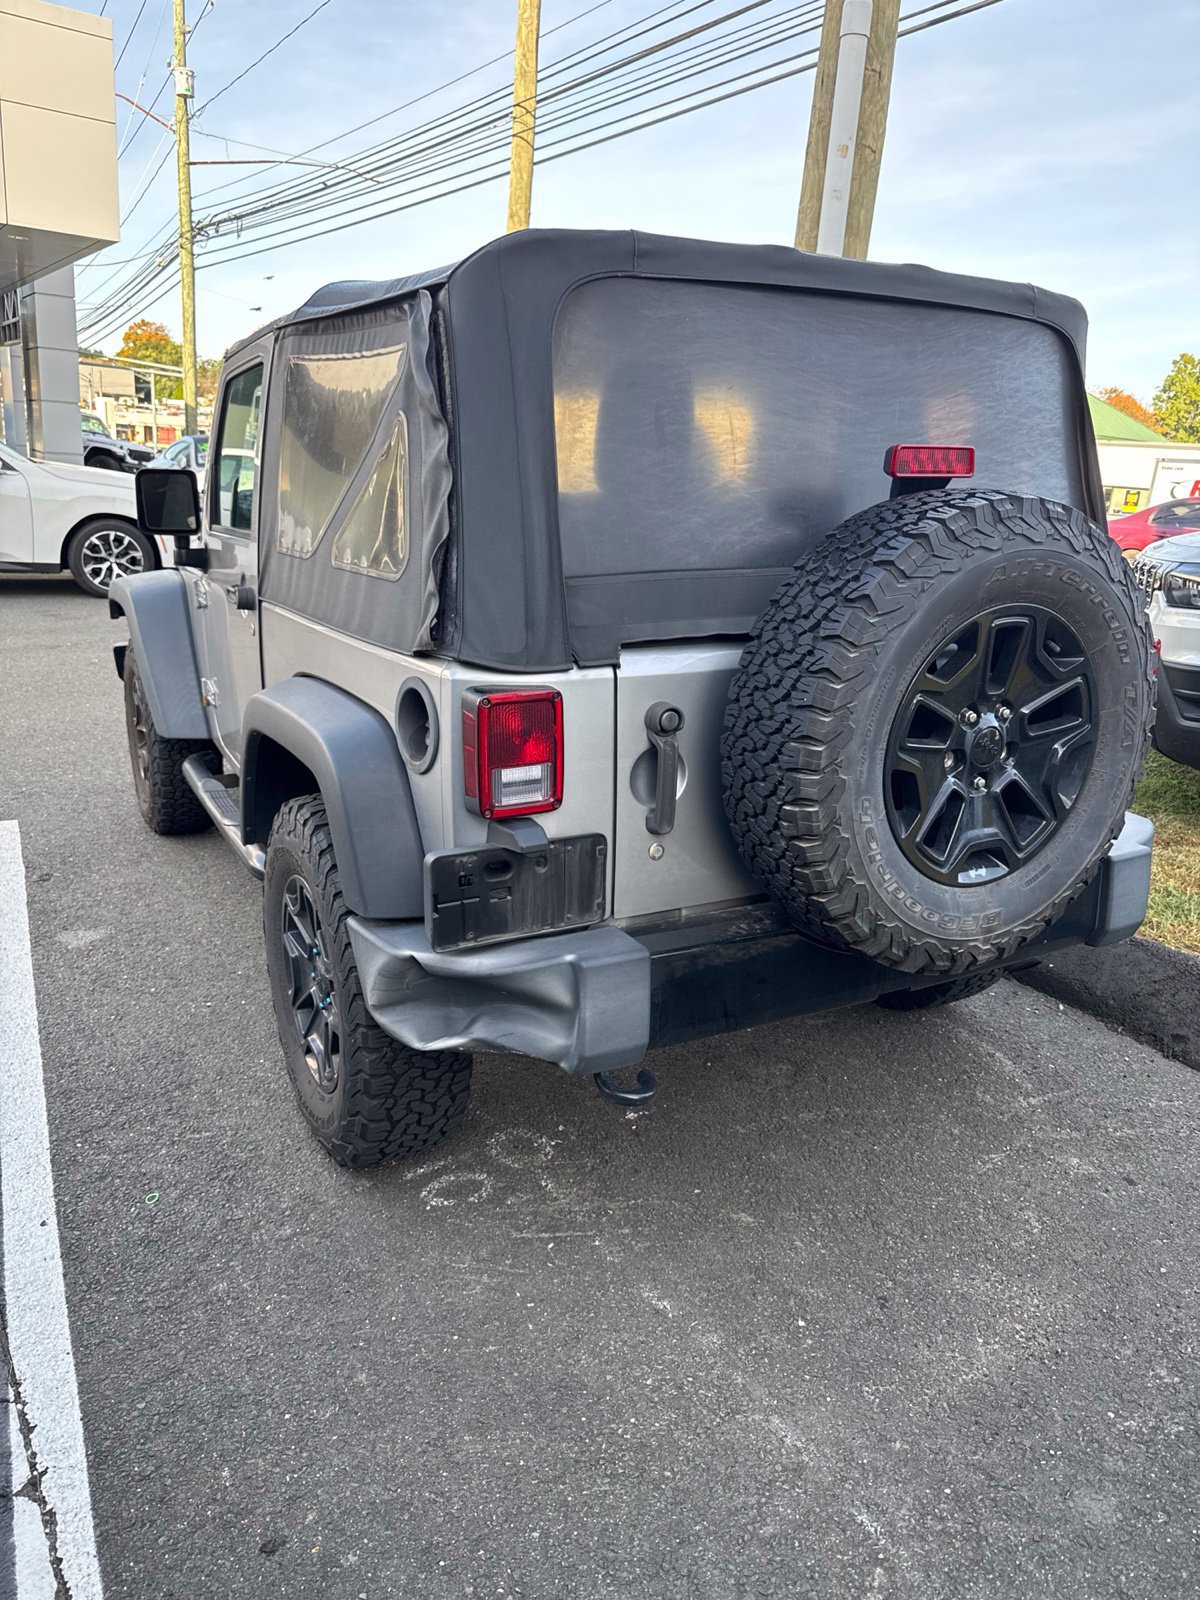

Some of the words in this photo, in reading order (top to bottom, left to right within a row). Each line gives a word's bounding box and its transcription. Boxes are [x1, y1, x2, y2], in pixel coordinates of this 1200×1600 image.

[985, 557, 1131, 665] All-Terrain
[1120, 680, 1138, 749] T/A
[858, 797, 1005, 932] BFGoodrich
